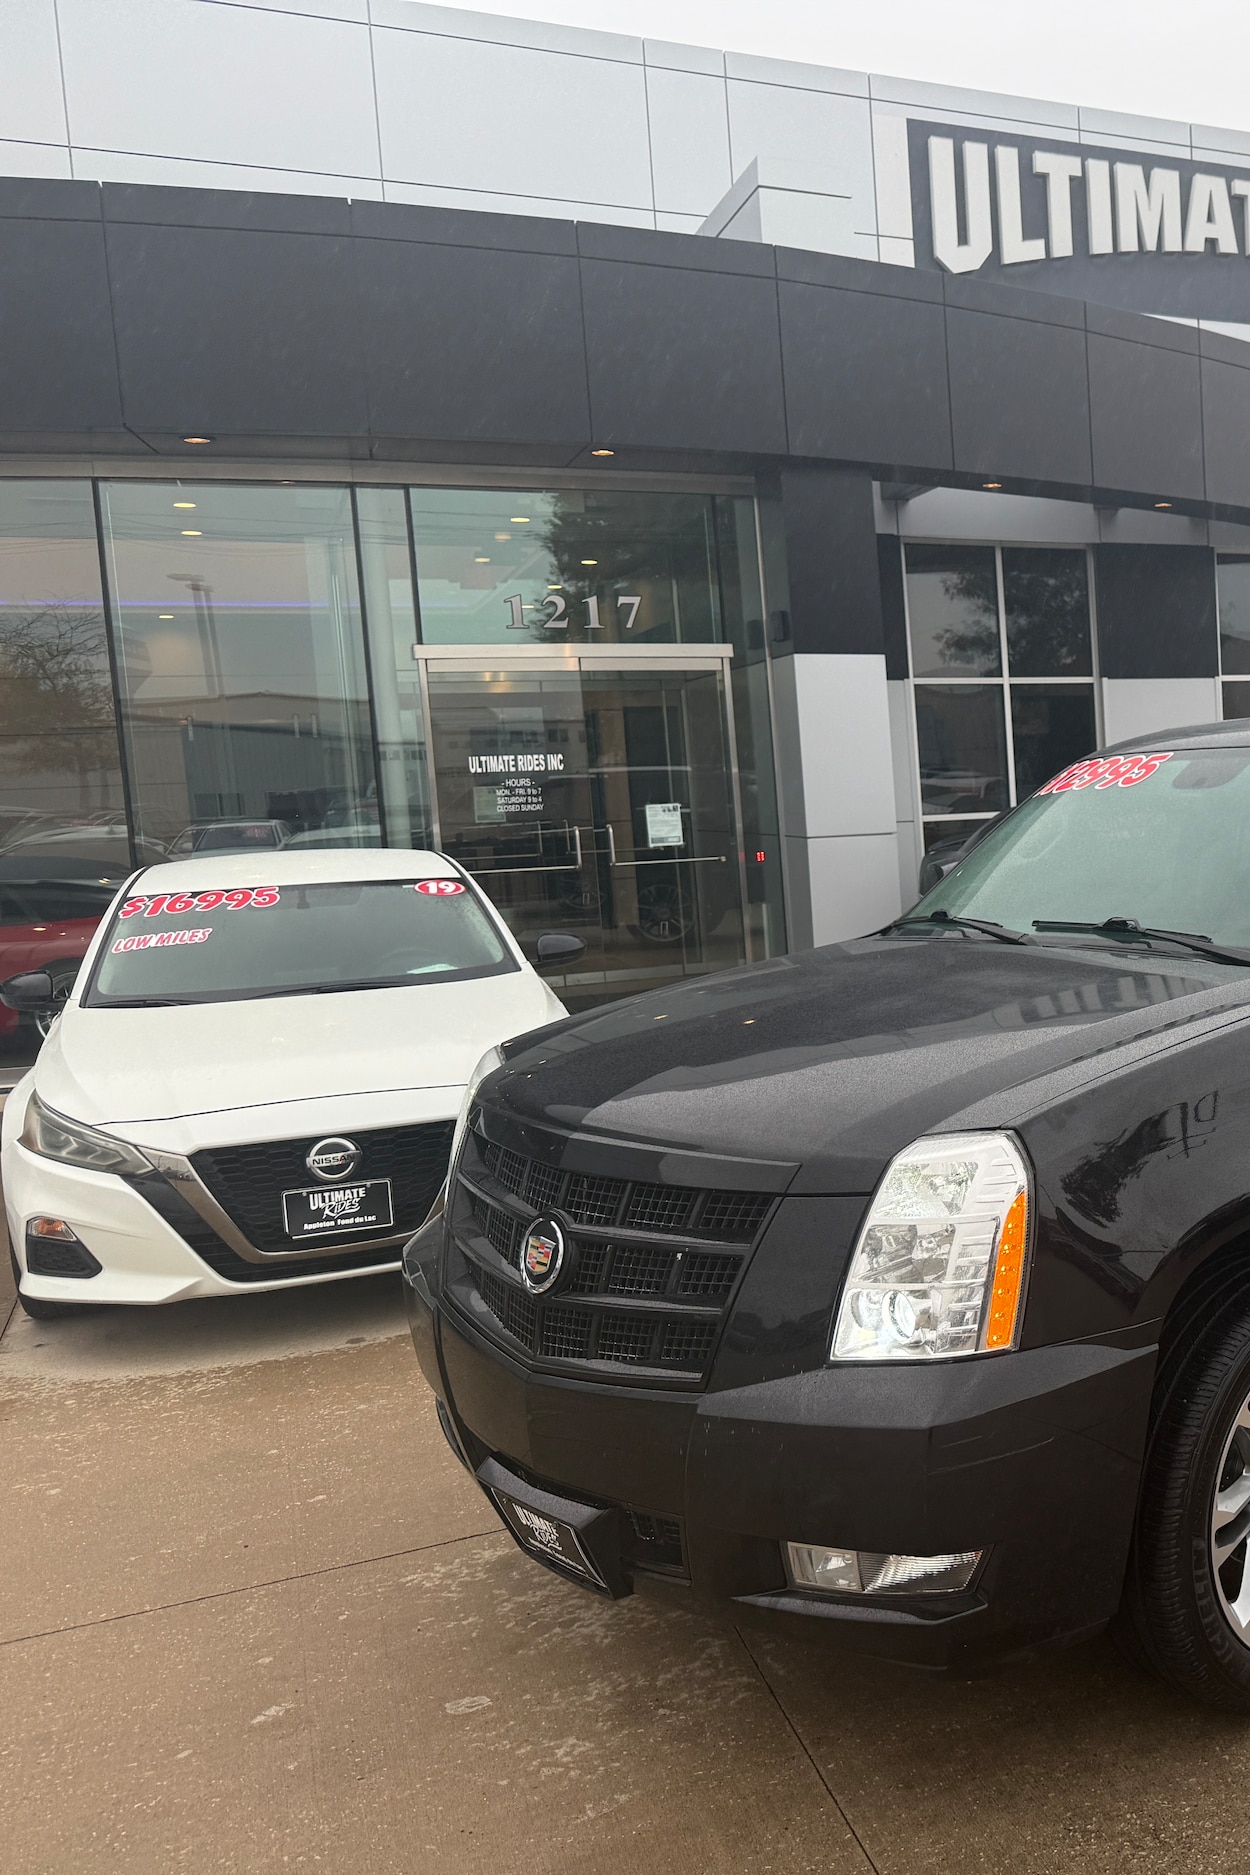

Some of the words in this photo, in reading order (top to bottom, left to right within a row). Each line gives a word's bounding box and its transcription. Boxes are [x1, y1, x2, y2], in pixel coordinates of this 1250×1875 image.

[503, 593, 642, 630] 1217
[468, 756, 516, 773] ULTIMATE
[517, 754, 546, 771] RIDES
[547, 753, 564, 770] INC
[505, 778, 531, 787] HOURS
[496, 804, 521, 812] CLOSED
[521, 803, 544, 811] SUNDAY
[497, 796, 527, 804] SATURDAY
[424, 880, 456, 894] 19
[118, 887, 280, 918] $16995
[112, 936, 152, 954] LOW
[152, 928, 212, 949] MILES
[312, 1153, 354, 1166] NISSAN
[309, 1187, 367, 1211] ULTIMATE
